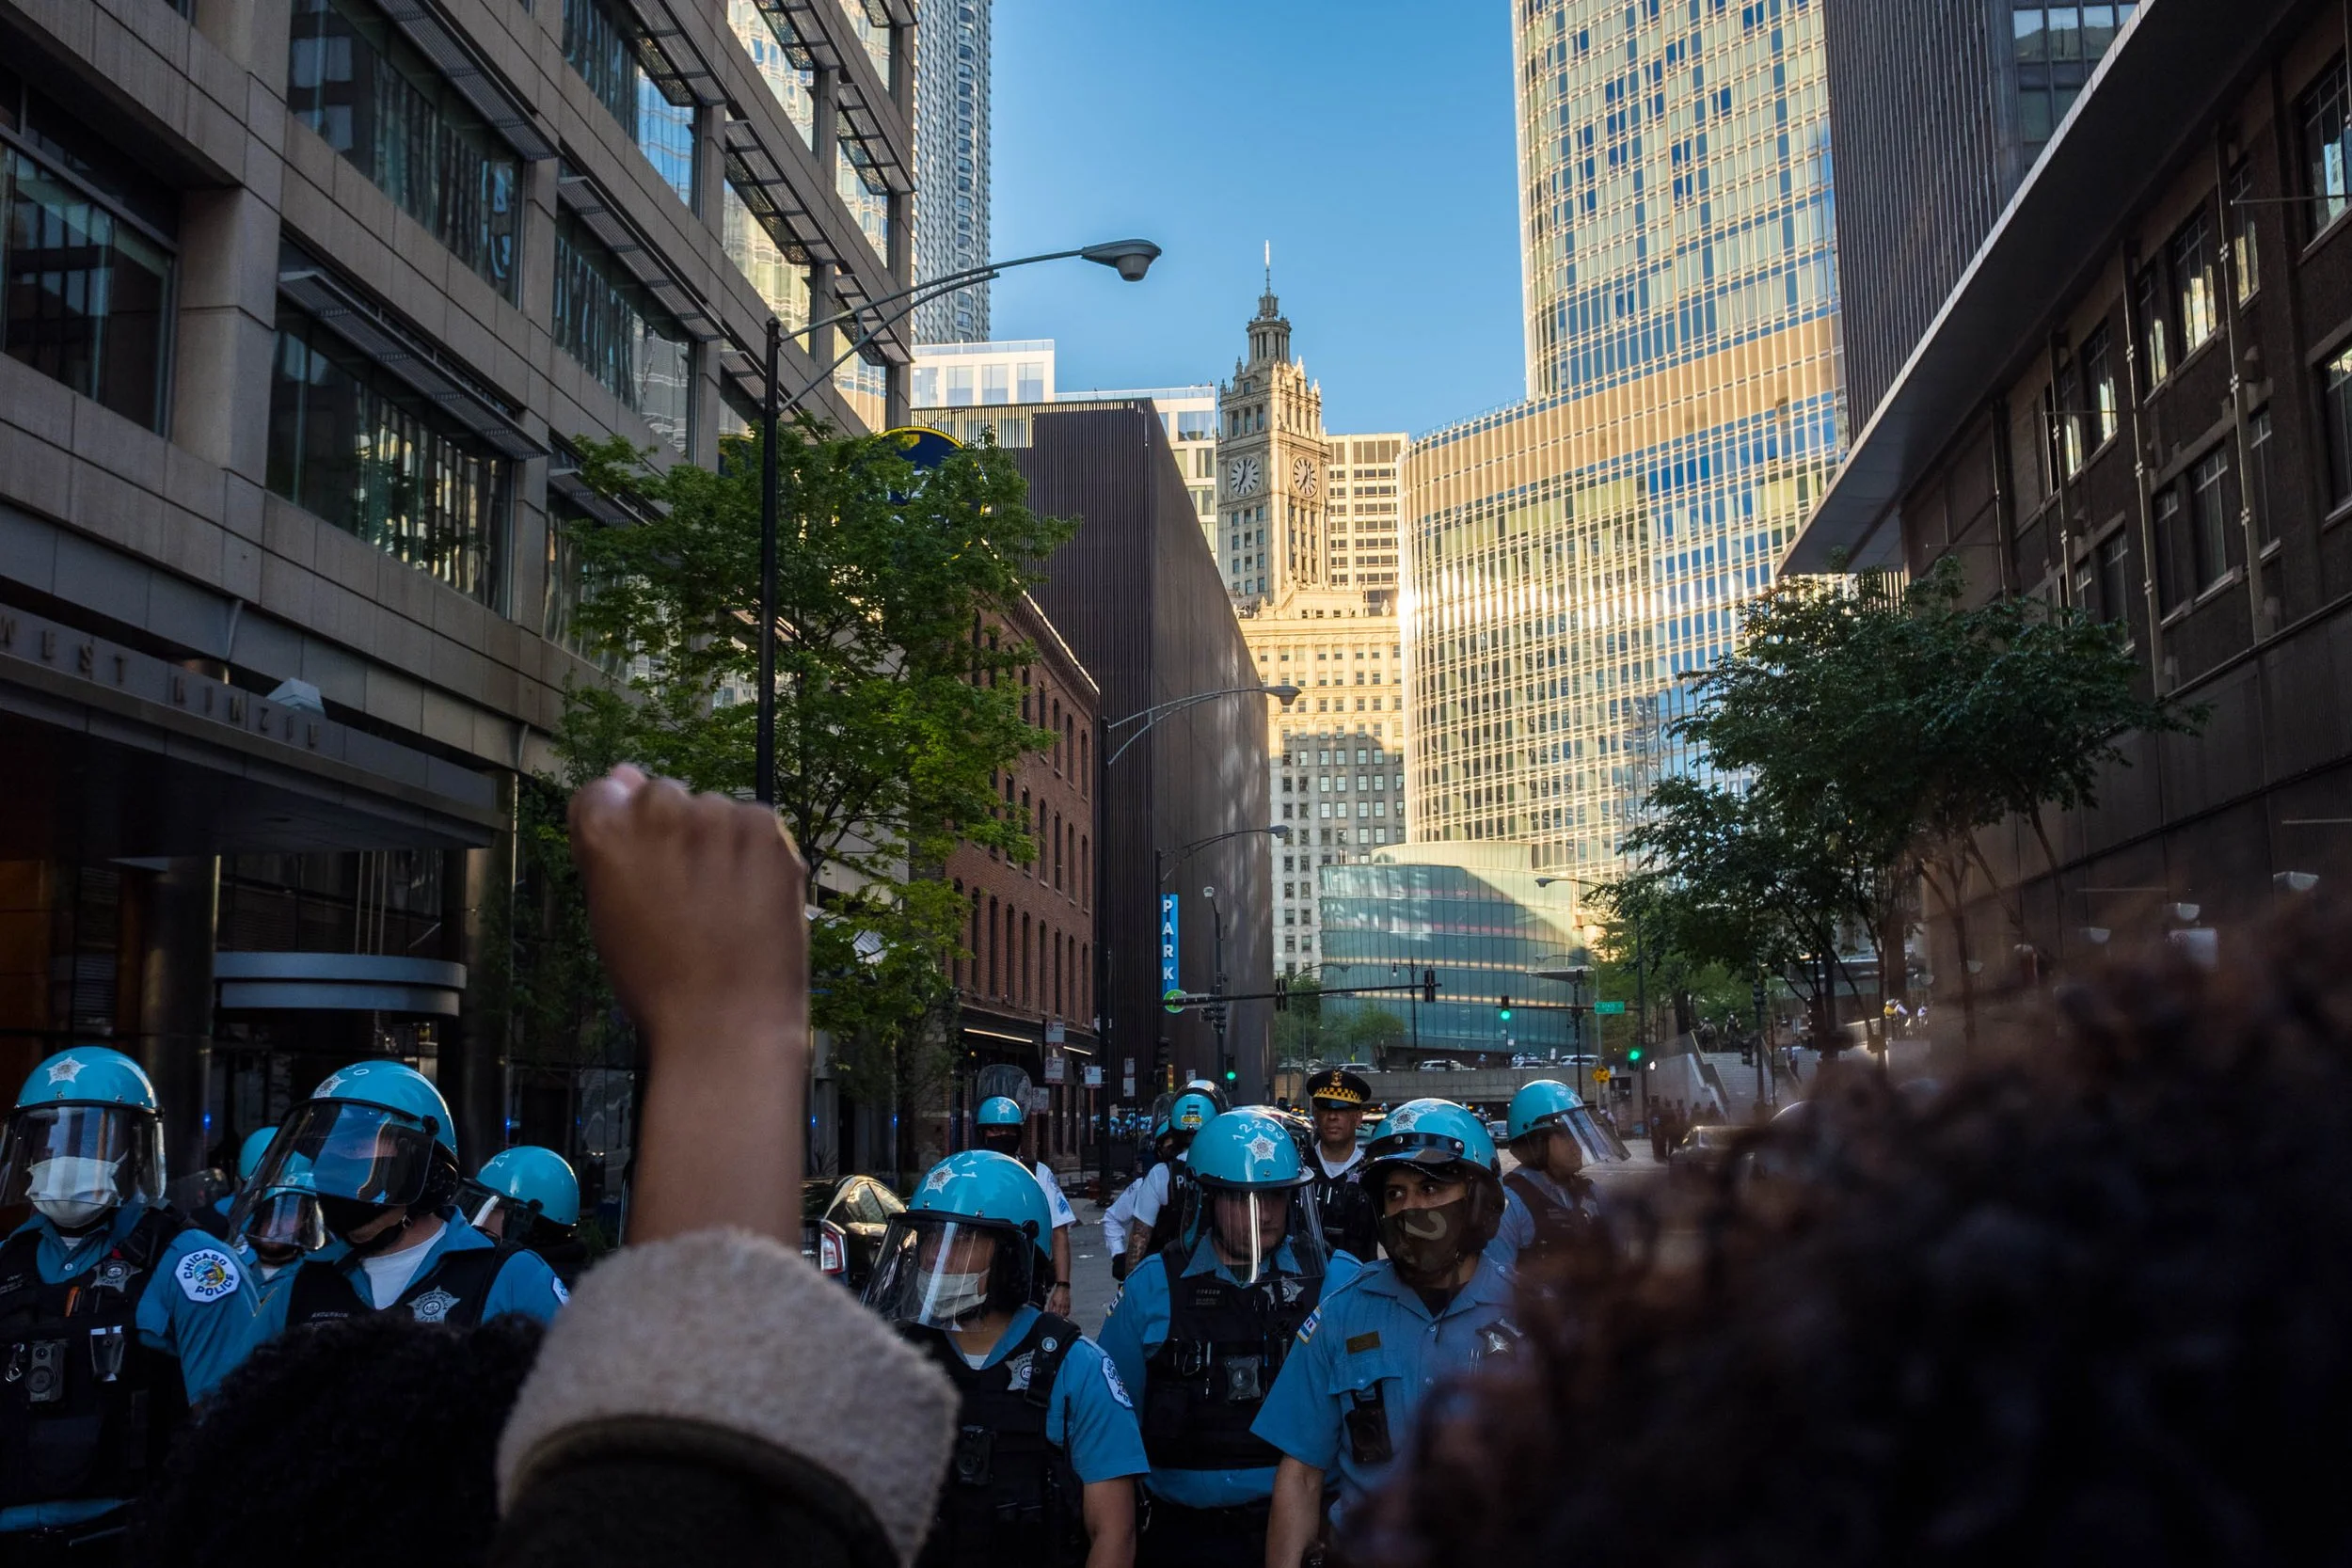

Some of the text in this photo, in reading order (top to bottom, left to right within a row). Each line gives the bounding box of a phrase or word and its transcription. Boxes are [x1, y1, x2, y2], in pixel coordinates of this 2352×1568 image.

[0, 618, 319, 749] WEST KINZIE
[1162, 899, 1174, 980] PARK
[183, 1253, 228, 1279] CHICAGO
[195, 1274, 234, 1296] POLICE
